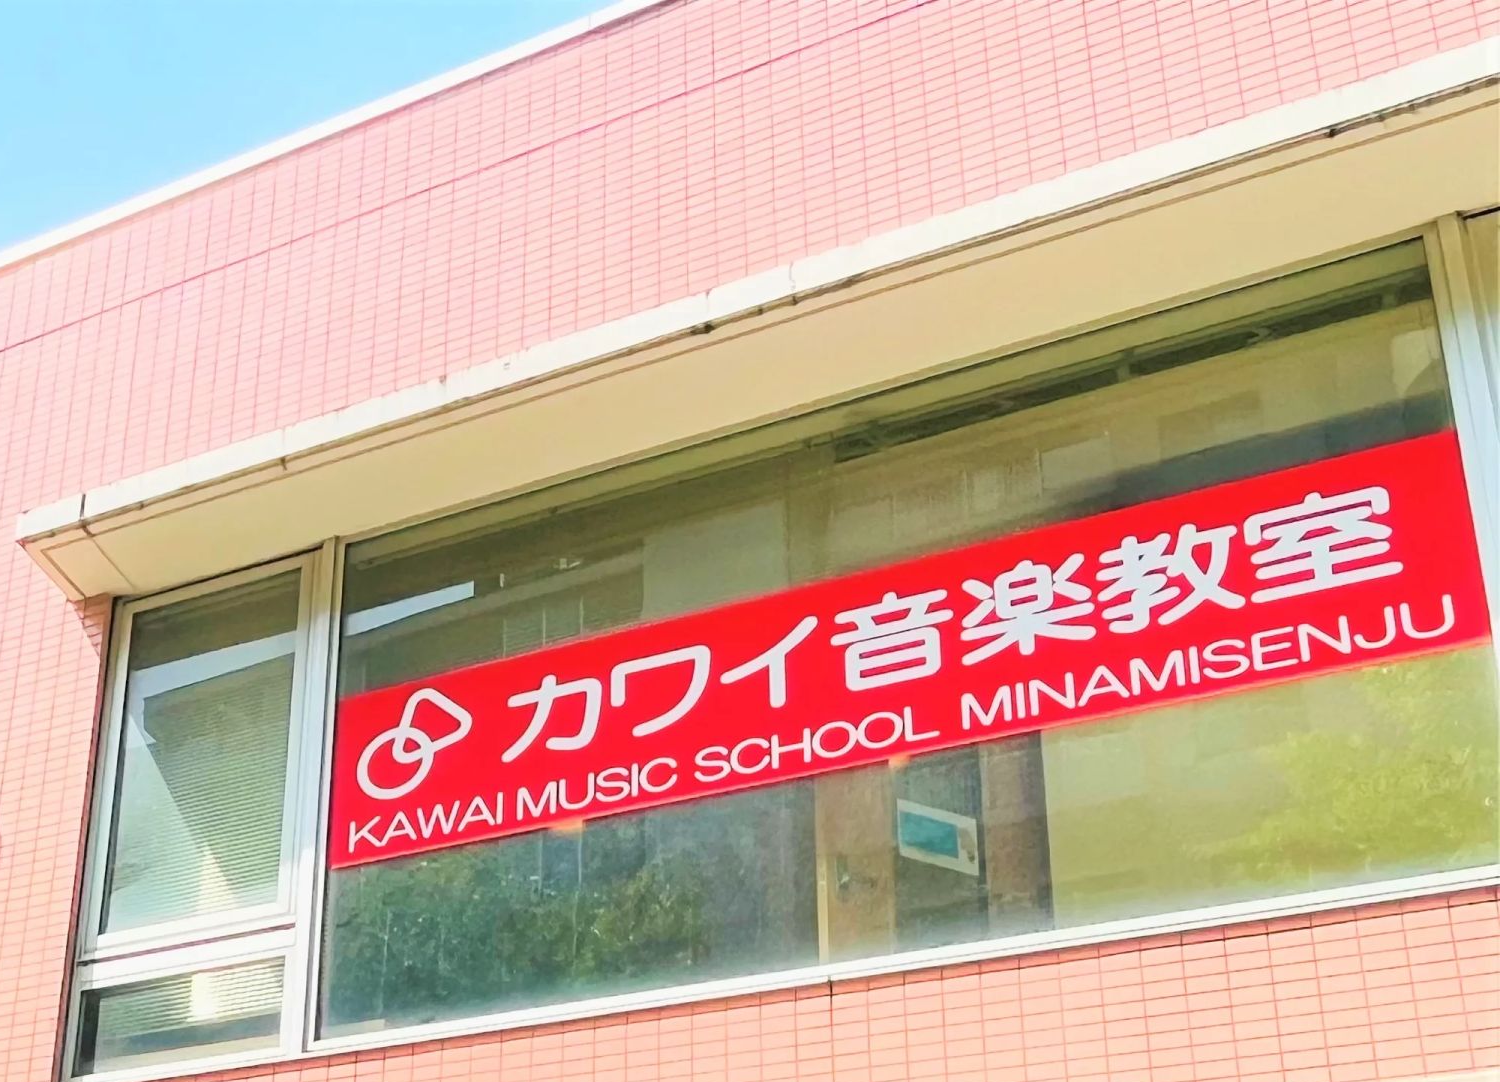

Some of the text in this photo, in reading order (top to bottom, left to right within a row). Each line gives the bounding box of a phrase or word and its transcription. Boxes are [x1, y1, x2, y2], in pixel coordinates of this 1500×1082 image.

[347, 594, 1456, 854] KAWAI MUSIC SCHOOL MINAMISENJU
[501, 484, 1404, 764] カワイ音楽教室
